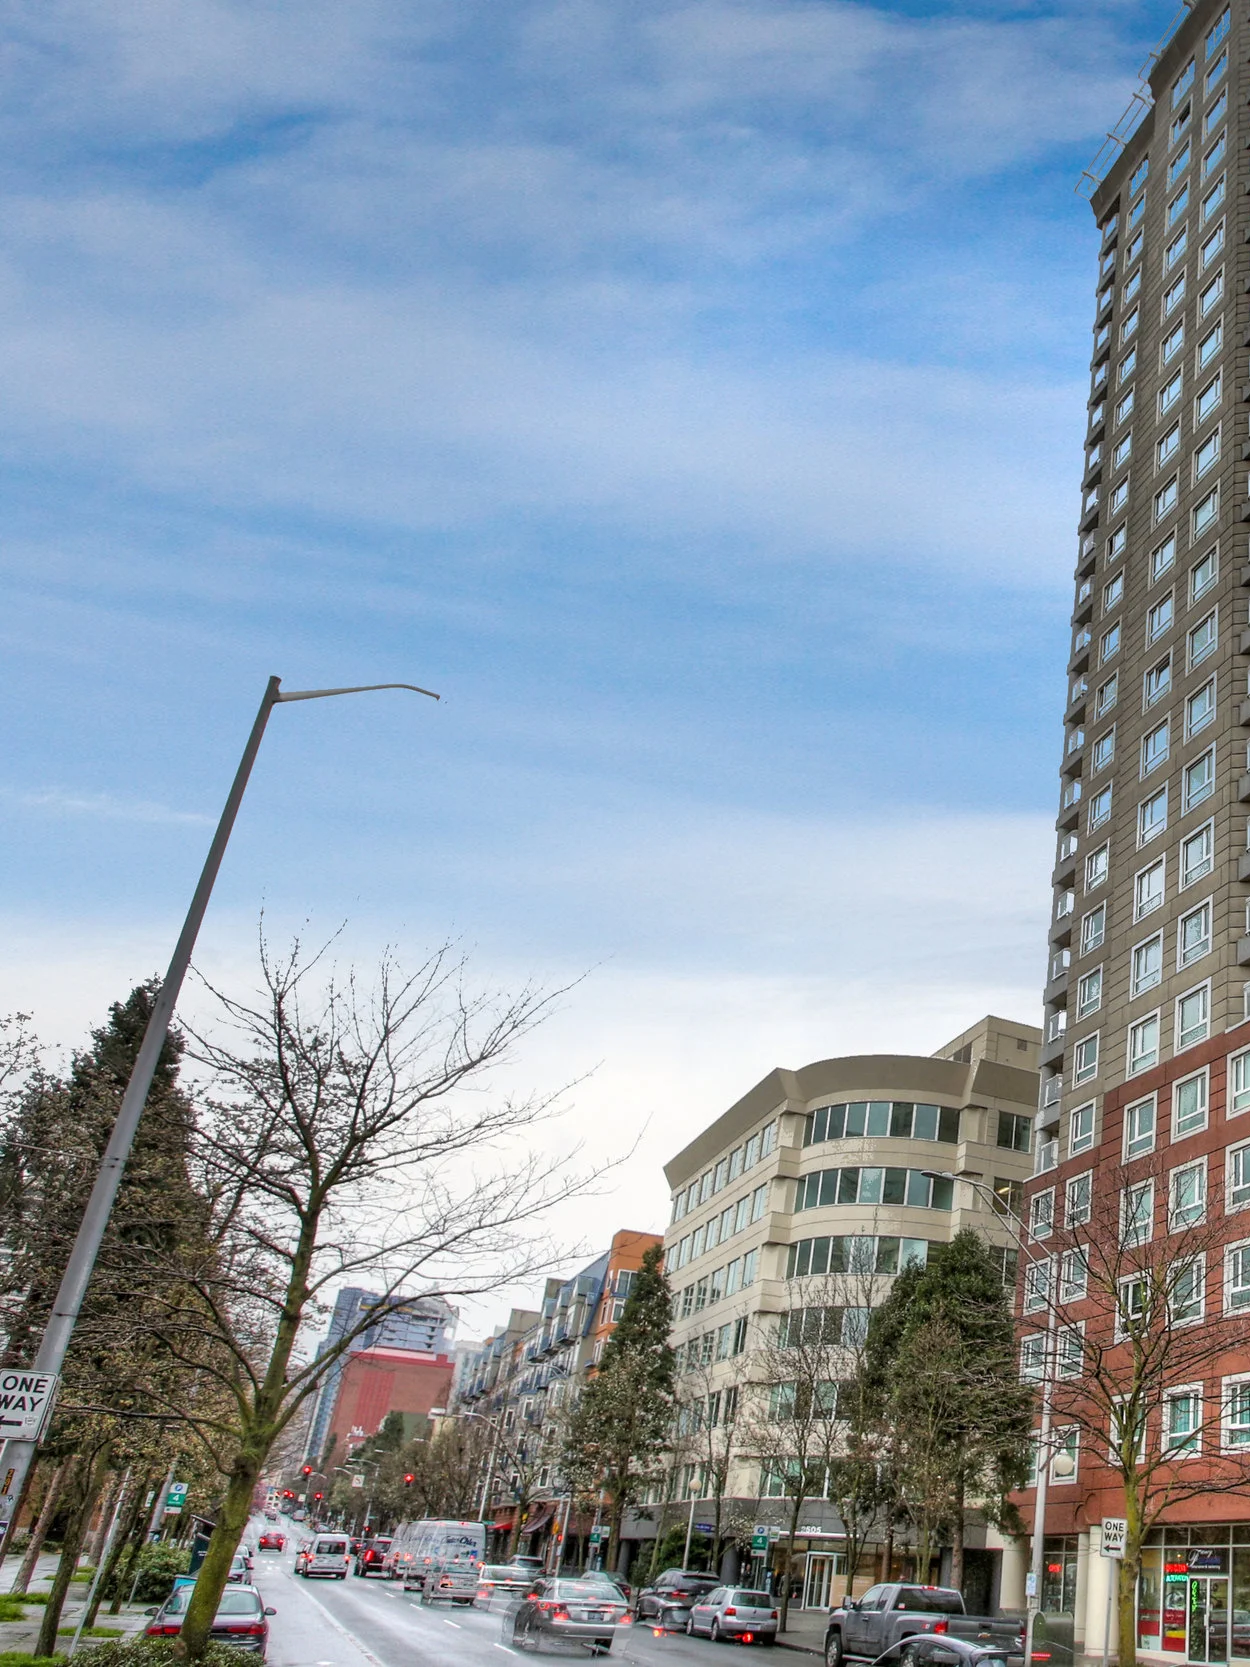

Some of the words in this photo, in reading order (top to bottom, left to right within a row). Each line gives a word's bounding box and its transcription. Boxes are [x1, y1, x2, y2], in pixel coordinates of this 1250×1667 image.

[3, 1375, 49, 1394] ONE
[0, 1394, 45, 1412] WAY
[173, 1494, 180, 1502] 4
[1105, 1521, 1125, 1532] ONE
[1104, 1532, 1124, 1542] WAY
